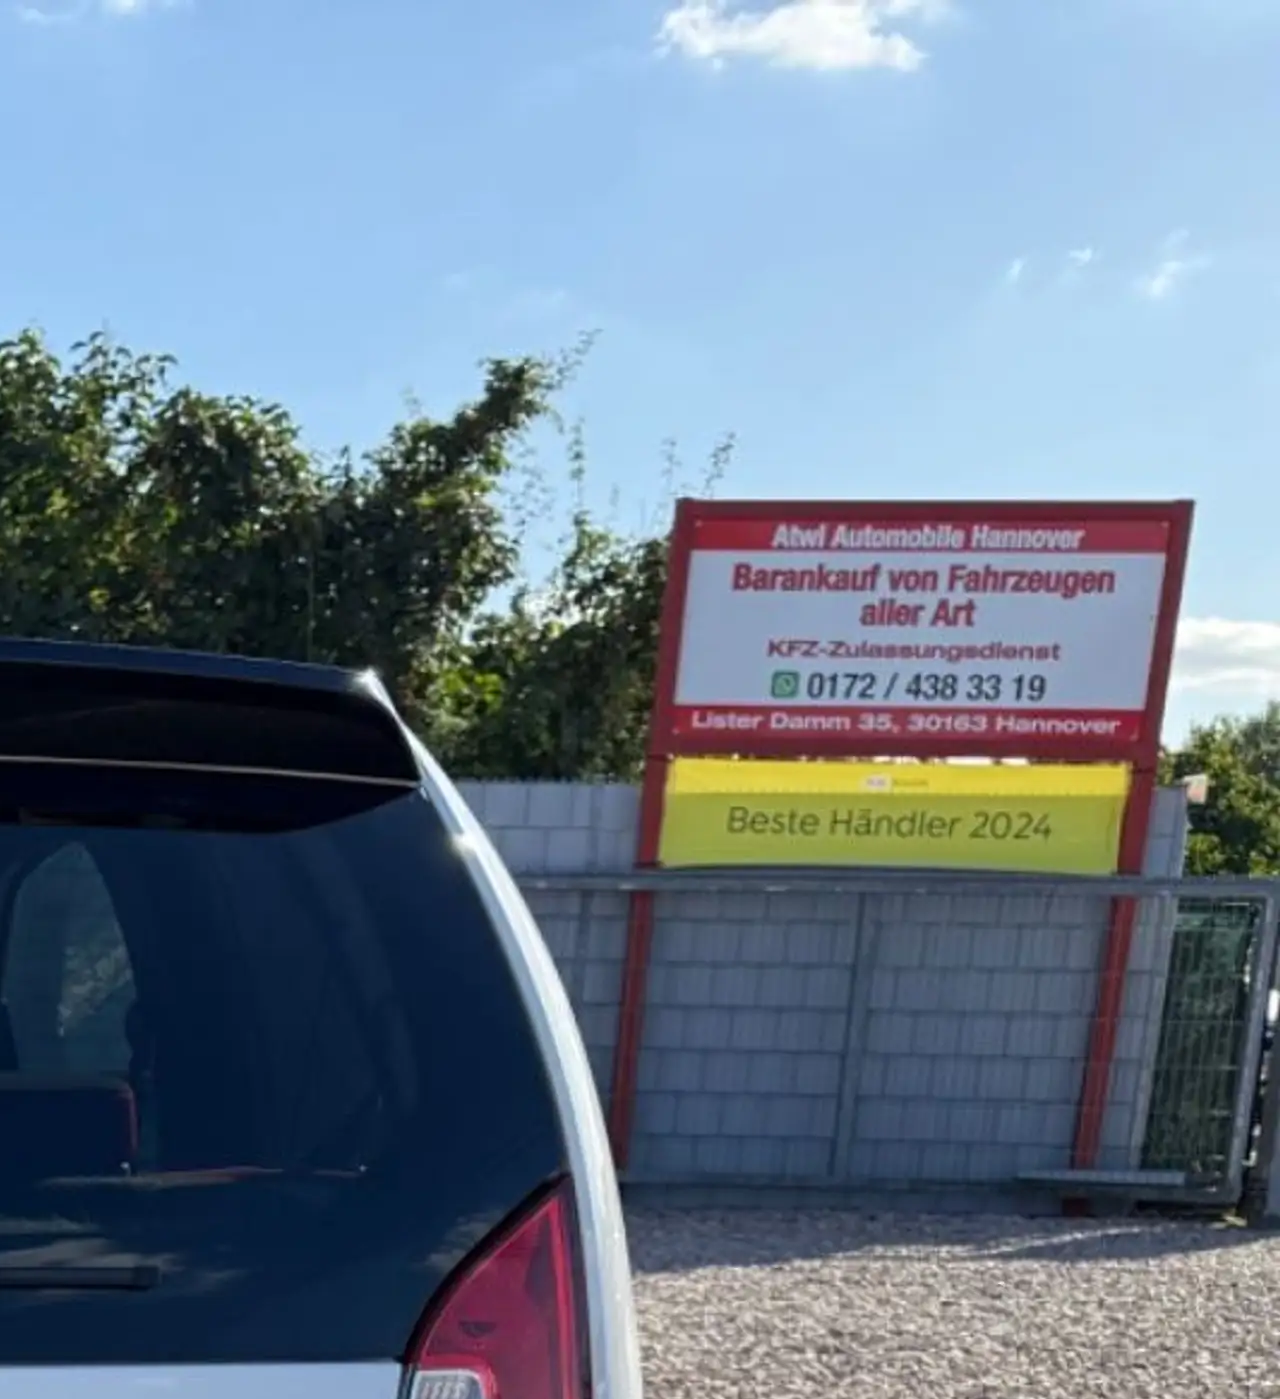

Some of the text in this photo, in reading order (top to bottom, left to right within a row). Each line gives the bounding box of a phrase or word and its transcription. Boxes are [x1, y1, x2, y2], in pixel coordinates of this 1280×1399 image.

[771, 523, 1086, 549] Atwi Automobile Hannover
[732, 563, 1115, 600] Barankauf von Fahrzeugen
[859, 598, 976, 628] aller Art
[767, 639, 1061, 663] KFZ-Zulassungsdienst
[806, 672, 1047, 702] 0172 / 438 33 19
[691, 710, 1121, 735] Lister Damm 35, 30163 Hannover
[726, 805, 1053, 840] Beste Händler 2024
